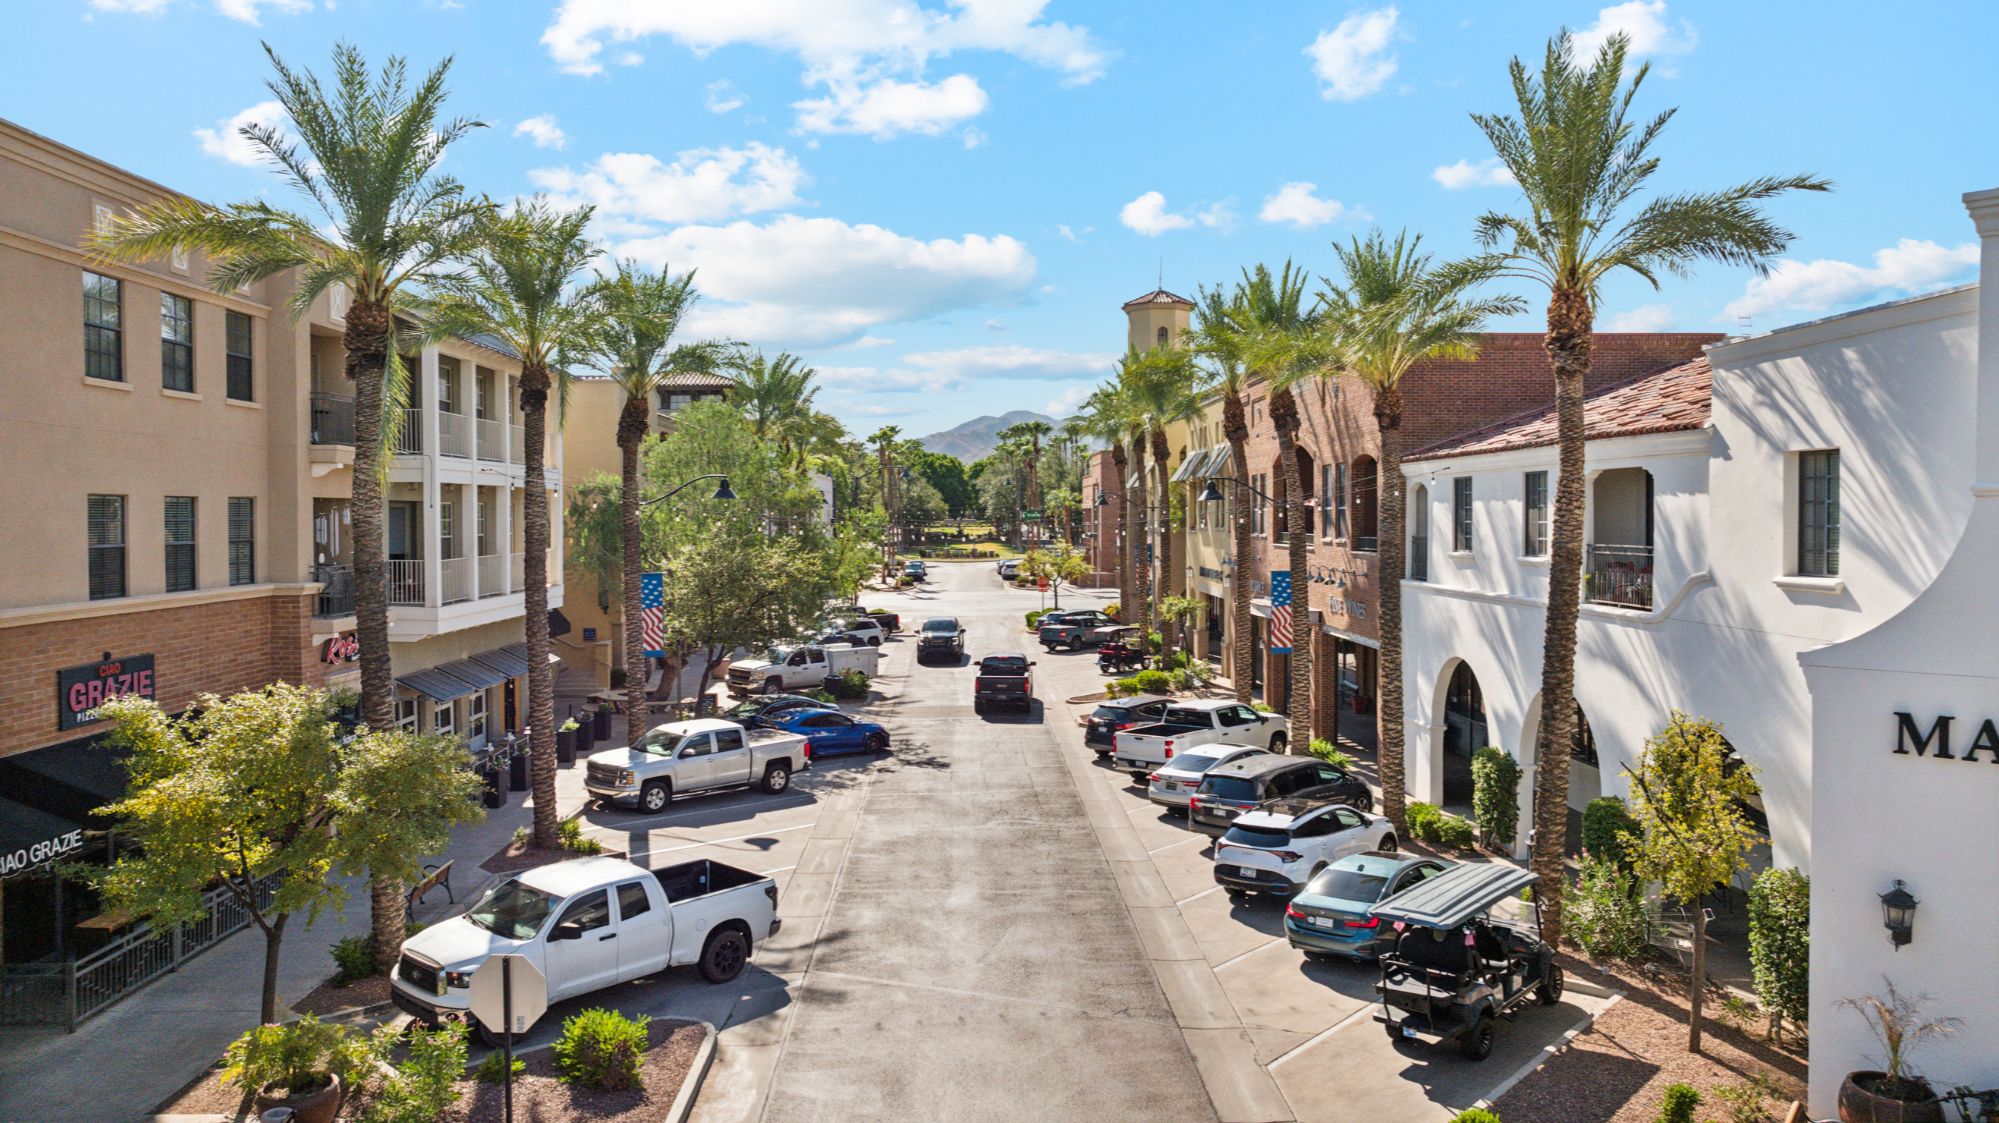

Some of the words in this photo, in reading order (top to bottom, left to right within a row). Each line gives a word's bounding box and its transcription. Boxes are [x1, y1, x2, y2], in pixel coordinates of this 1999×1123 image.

[69, 669, 153, 712] GRAZIE
[99, 662, 122, 678] CIAO
[1892, 711, 1999, 765] MA
[0, 849, 28, 875] IAO
[29, 828, 83, 862] GRAZIE
